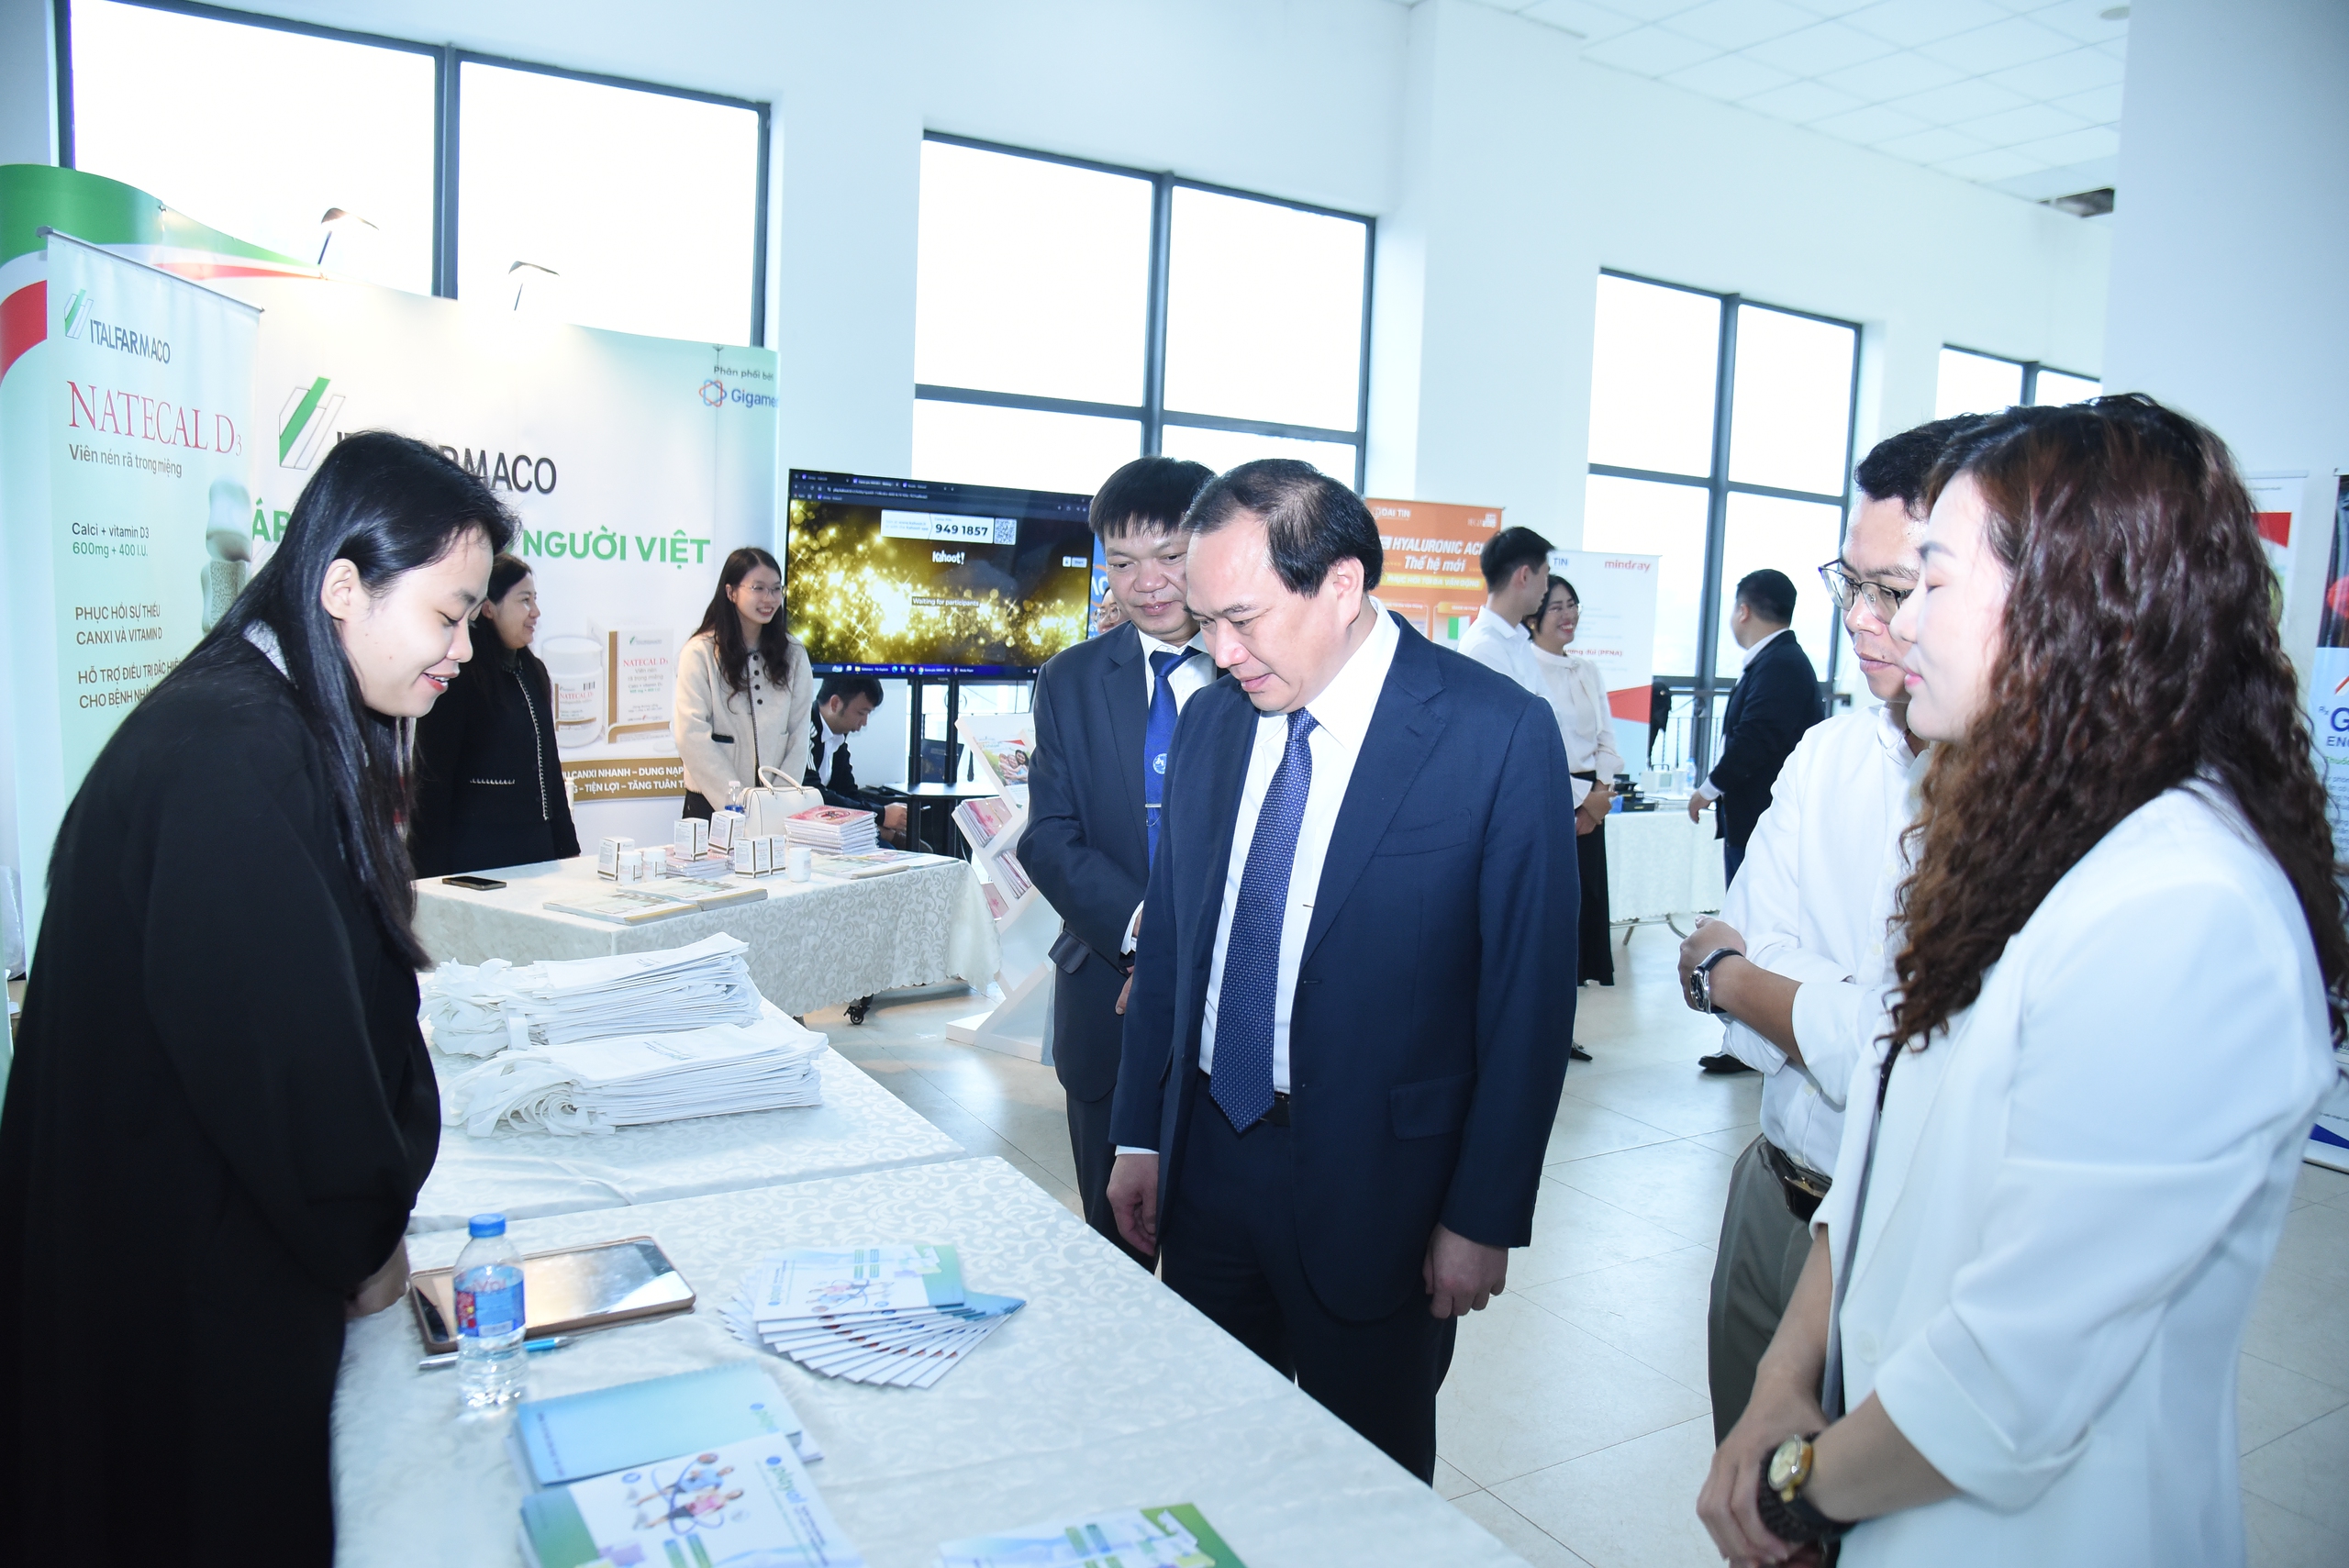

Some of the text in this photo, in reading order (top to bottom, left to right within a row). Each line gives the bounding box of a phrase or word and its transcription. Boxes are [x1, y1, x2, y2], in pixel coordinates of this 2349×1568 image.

[89, 318, 172, 364] ITALFARMACO
[731, 388, 779, 409] Gigame
[66, 380, 208, 450] NATECAL
[69, 443, 183, 479] Viên nén rã trong miệng
[72, 522, 98, 536] Calci
[108, 524, 139, 539] vitamin
[139, 527, 150, 539] D3
[935, 523, 959, 535] 949
[962, 526, 989, 538] 1857
[72, 541, 109, 559] 600mg
[118, 544, 135, 556] 400
[523, 525, 711, 570] NGƯỜI VIỆT
[1391, 537, 1485, 556] HYALURONIC ACI
[932, 550, 965, 566] Kahoot!
[1404, 555, 1466, 574] Thế hệ mới
[1604, 560, 1651, 573] mindray
[912, 597, 936, 606] Waiting
[945, 599, 979, 607] participants
[74, 600, 161, 624] PHỤC HỒI SỰ THIẾU
[76, 629, 113, 646] CANXI
[115, 626, 128, 644] VÀ
[128, 628, 158, 643] VITAMIN
[623, 658, 657, 668] NATECAL
[78, 665, 97, 684] HỖ
[99, 665, 121, 684] TRỢ
[122, 662, 142, 681] ĐIỀU
[80, 694, 106, 709] CHO
[108, 687, 133, 709] BỆNH
[572, 769, 596, 780] CANXI
[597, 768, 630, 778] NHANH
[639, 767, 662, 776] DUNG
[665, 766, 685, 778] NẠP
[584, 781, 603, 795] TIỆN
[604, 782, 620, 794] LỢI
[628, 780, 652, 791] TĂNG
[652, 779, 676, 790] TUÂN
